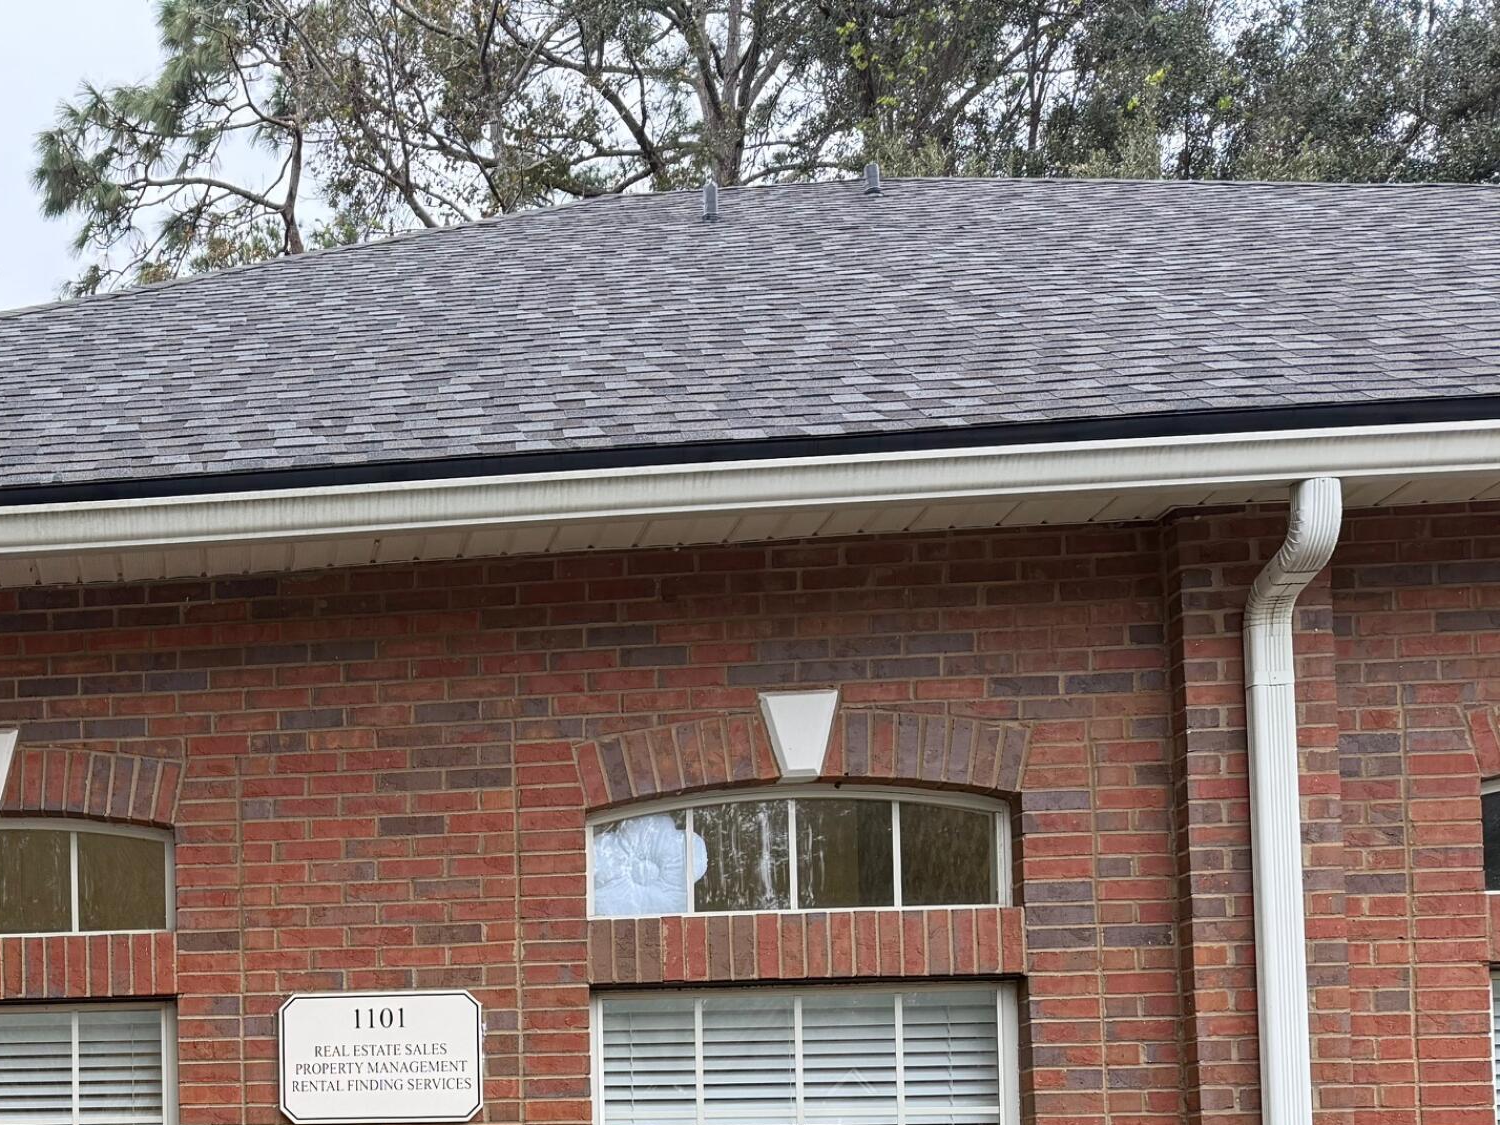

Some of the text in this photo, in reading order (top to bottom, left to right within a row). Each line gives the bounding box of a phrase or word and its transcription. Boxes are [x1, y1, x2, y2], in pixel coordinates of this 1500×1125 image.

[353, 1007, 405, 1029] 1101
[314, 1043, 447, 1058] REAL ESTATE SALES
[295, 1060, 467, 1076] PROPERTY MANAGEMENT
[292, 1077, 472, 1092] RENTAL FINDING SERVICES
